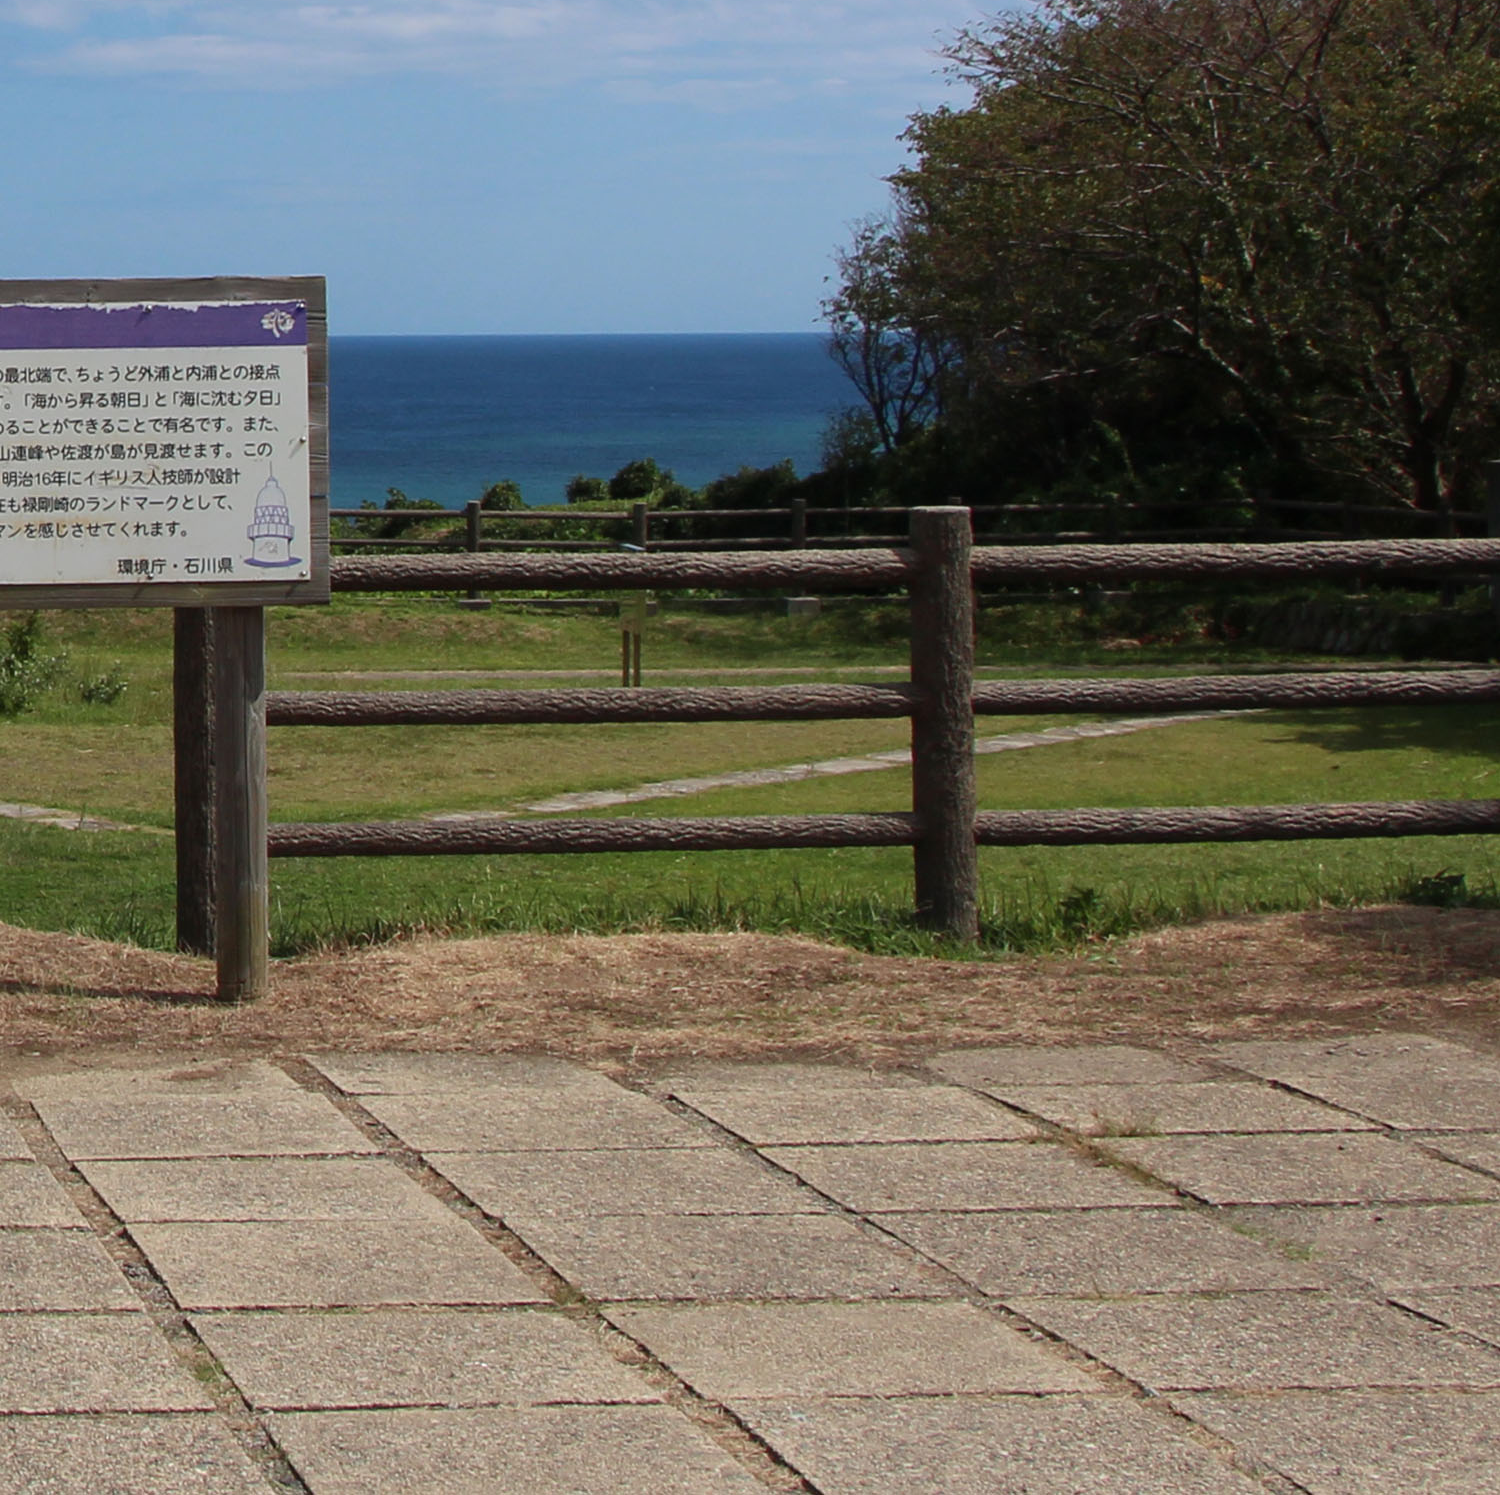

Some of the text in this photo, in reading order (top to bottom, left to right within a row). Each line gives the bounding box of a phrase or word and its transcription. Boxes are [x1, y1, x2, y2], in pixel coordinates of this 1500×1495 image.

[117, 558, 234, 575] 環境庁・石川県
